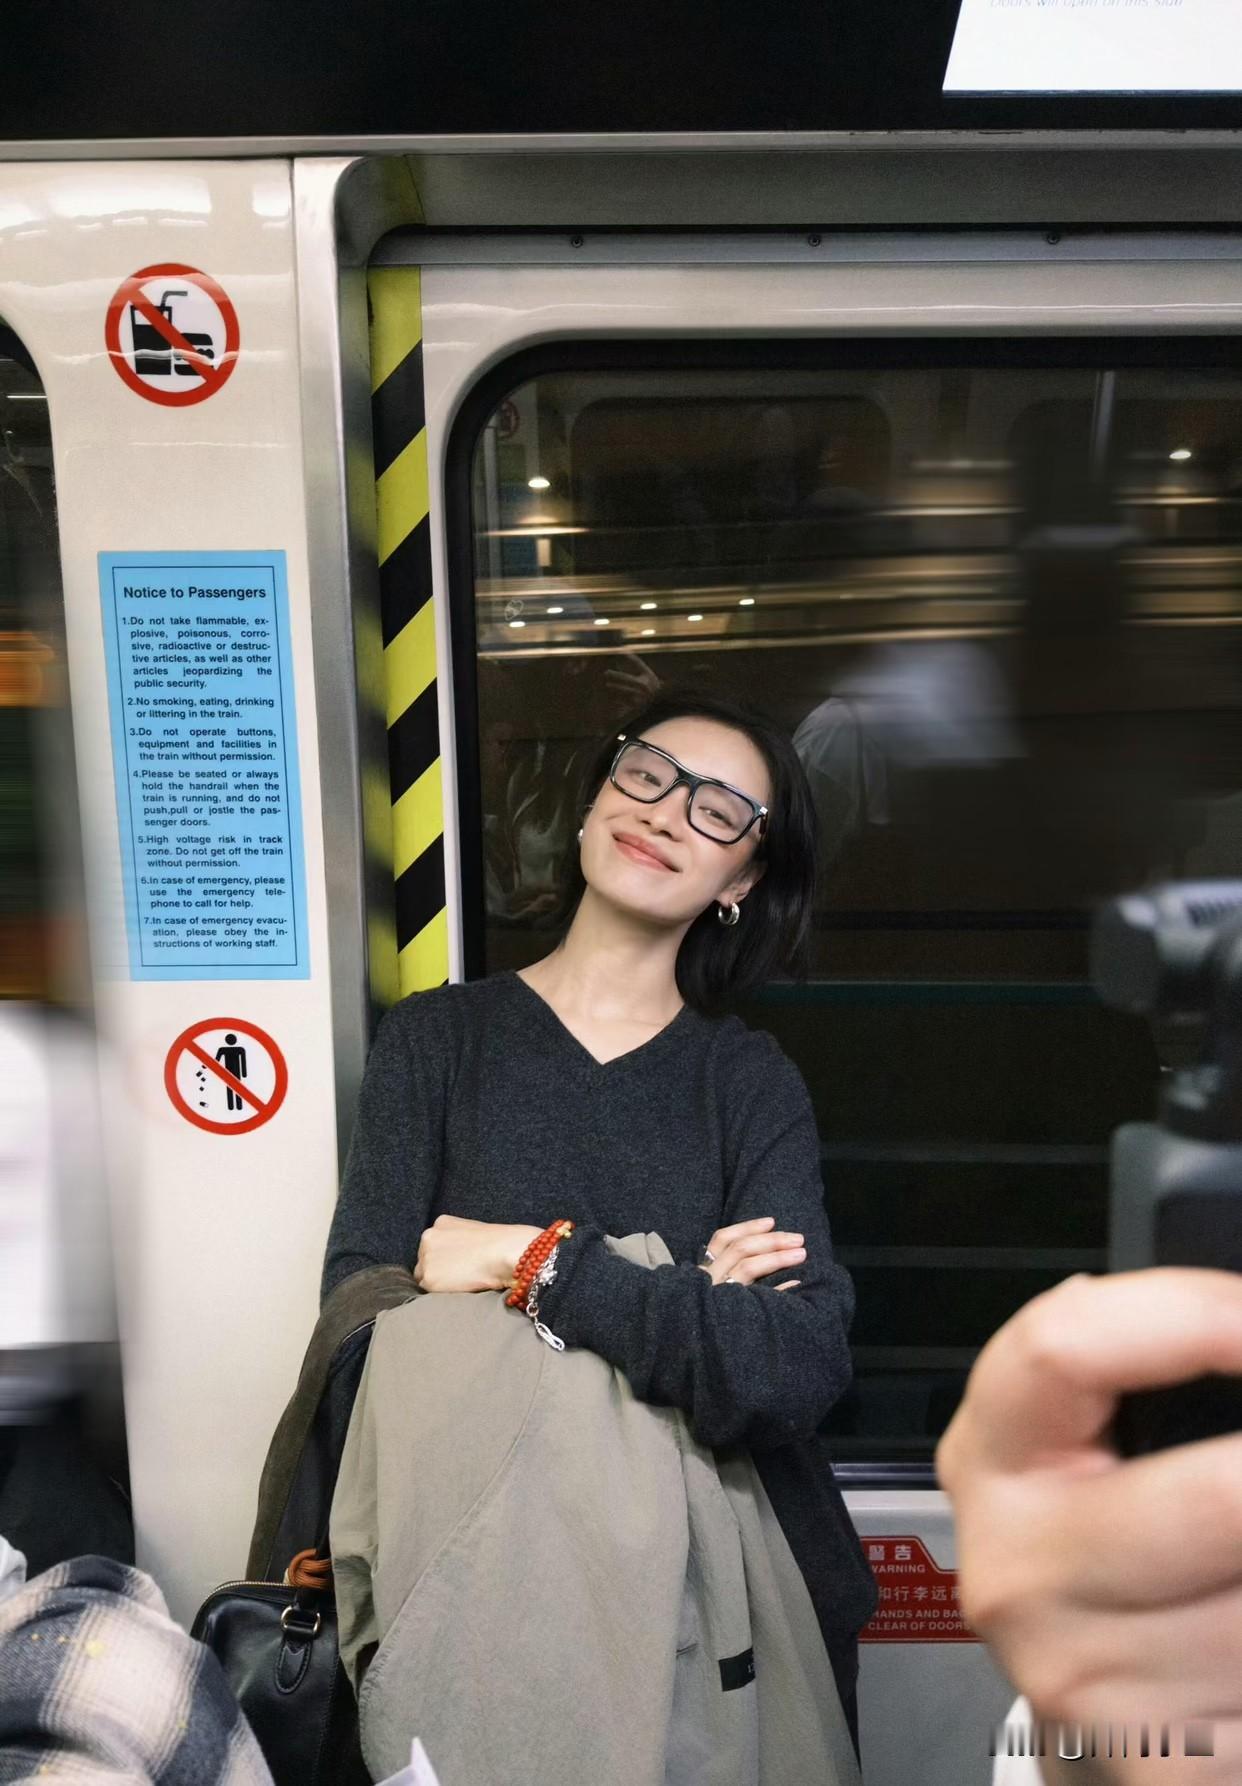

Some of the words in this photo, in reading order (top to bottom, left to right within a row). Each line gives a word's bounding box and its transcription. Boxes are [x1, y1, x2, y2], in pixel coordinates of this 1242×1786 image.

[124, 587, 167, 598] Notice
[170, 587, 184, 598] to
[188, 586, 266, 601] Passengers
[149, 617, 165, 625] not
[170, 616, 191, 625] take
[196, 616, 249, 626] flammable,
[131, 629, 168, 640] plosive,
[178, 629, 231, 640] poisonous,
[131, 642, 154, 651] sive,
[158, 641, 212, 650] radioactive
[231, 642, 271, 650] destruc-
[132, 654, 151, 663] tive
[153, 654, 192, 664] articles,
[193, 656, 206, 664] as
[209, 654, 228, 663] well
[246, 654, 272, 663] other
[133, 666, 168, 675] articles
[183, 667, 243, 677] jeopardizing
[257, 667, 272, 675] the
[134, 679, 164, 690] public
[167, 679, 207, 690] security.
[153, 697, 197, 707] smoking,
[200, 697, 232, 708] eating,
[235, 697, 274, 708] drinking
[149, 709, 186, 720] littering
[188, 710, 197, 718] in
[200, 709, 215, 718] the
[217, 709, 243, 718] train.
[163, 728, 179, 736] not
[189, 728, 226, 738] operate
[237, 728, 276, 737] buttons,
[138, 740, 189, 750] equipment
[196, 740, 214, 748] and
[221, 740, 262, 748] facilities
[268, 740, 277, 748] in
[139, 752, 155, 760] the
[157, 752, 179, 760] train
[182, 752, 217, 760] without
[219, 752, 275, 763] permission.
[178, 770, 190, 778] be
[195, 770, 227, 778] seated
[246, 770, 279, 780] always
[142, 782, 163, 790] hold
[168, 782, 184, 790] the
[189, 782, 228, 791] handrail
[234, 782, 259, 790] when
[264, 782, 279, 790] the
[142, 794, 164, 802] train
[169, 794, 178, 802] is
[182, 794, 221, 804] running,
[226, 794, 244, 802] and
[248, 794, 260, 802] do
[265, 794, 280, 802] not
[193, 807, 203, 815] or
[209, 806, 235, 816] jostle
[240, 806, 255, 814] the
[260, 808, 281, 816] pas-
[144, 819, 178, 828] senger
[180, 818, 211, 826] doors.
[176, 835, 211, 845] voltage
[218, 835, 236, 843] risk
[243, 835, 252, 843] in
[259, 835, 283, 843] track
[146, 848, 173, 857] zone.
[176, 847, 189, 855] Do
[192, 847, 207, 855] not
[210, 848, 226, 857] get
[228, 847, 241, 855] off
[244, 847, 259, 855] the
[262, 847, 283, 855] train
[147, 859, 183, 867] without
[185, 859, 240, 869] permission.
[185, 876, 195, 884] of
[197, 877, 252, 886] emergency,
[254, 876, 285, 886] please
[177, 888, 192, 896] the
[202, 889, 255, 898] emergency
[265, 888, 286, 896] tele-
[150, 900, 181, 909] phone
[194, 899, 212, 908] call
[214, 899, 227, 907] for
[230, 899, 253, 909] help.
[189, 916, 199, 924] of
[201, 918, 253, 926] emergency
[152, 927, 179, 936] ation,
[186, 928, 217, 937] please
[224, 928, 247, 937] obey
[254, 928, 269, 936] the
[153, 939, 201, 948] structions
[203, 939, 212, 947] of
[215, 939, 252, 949] working
[255, 939, 277, 947] staff.
[915, 1609, 940, 1618] AND
[868, 1621, 907, 1630] CLEAR
[910, 1621, 926, 1630] OF
